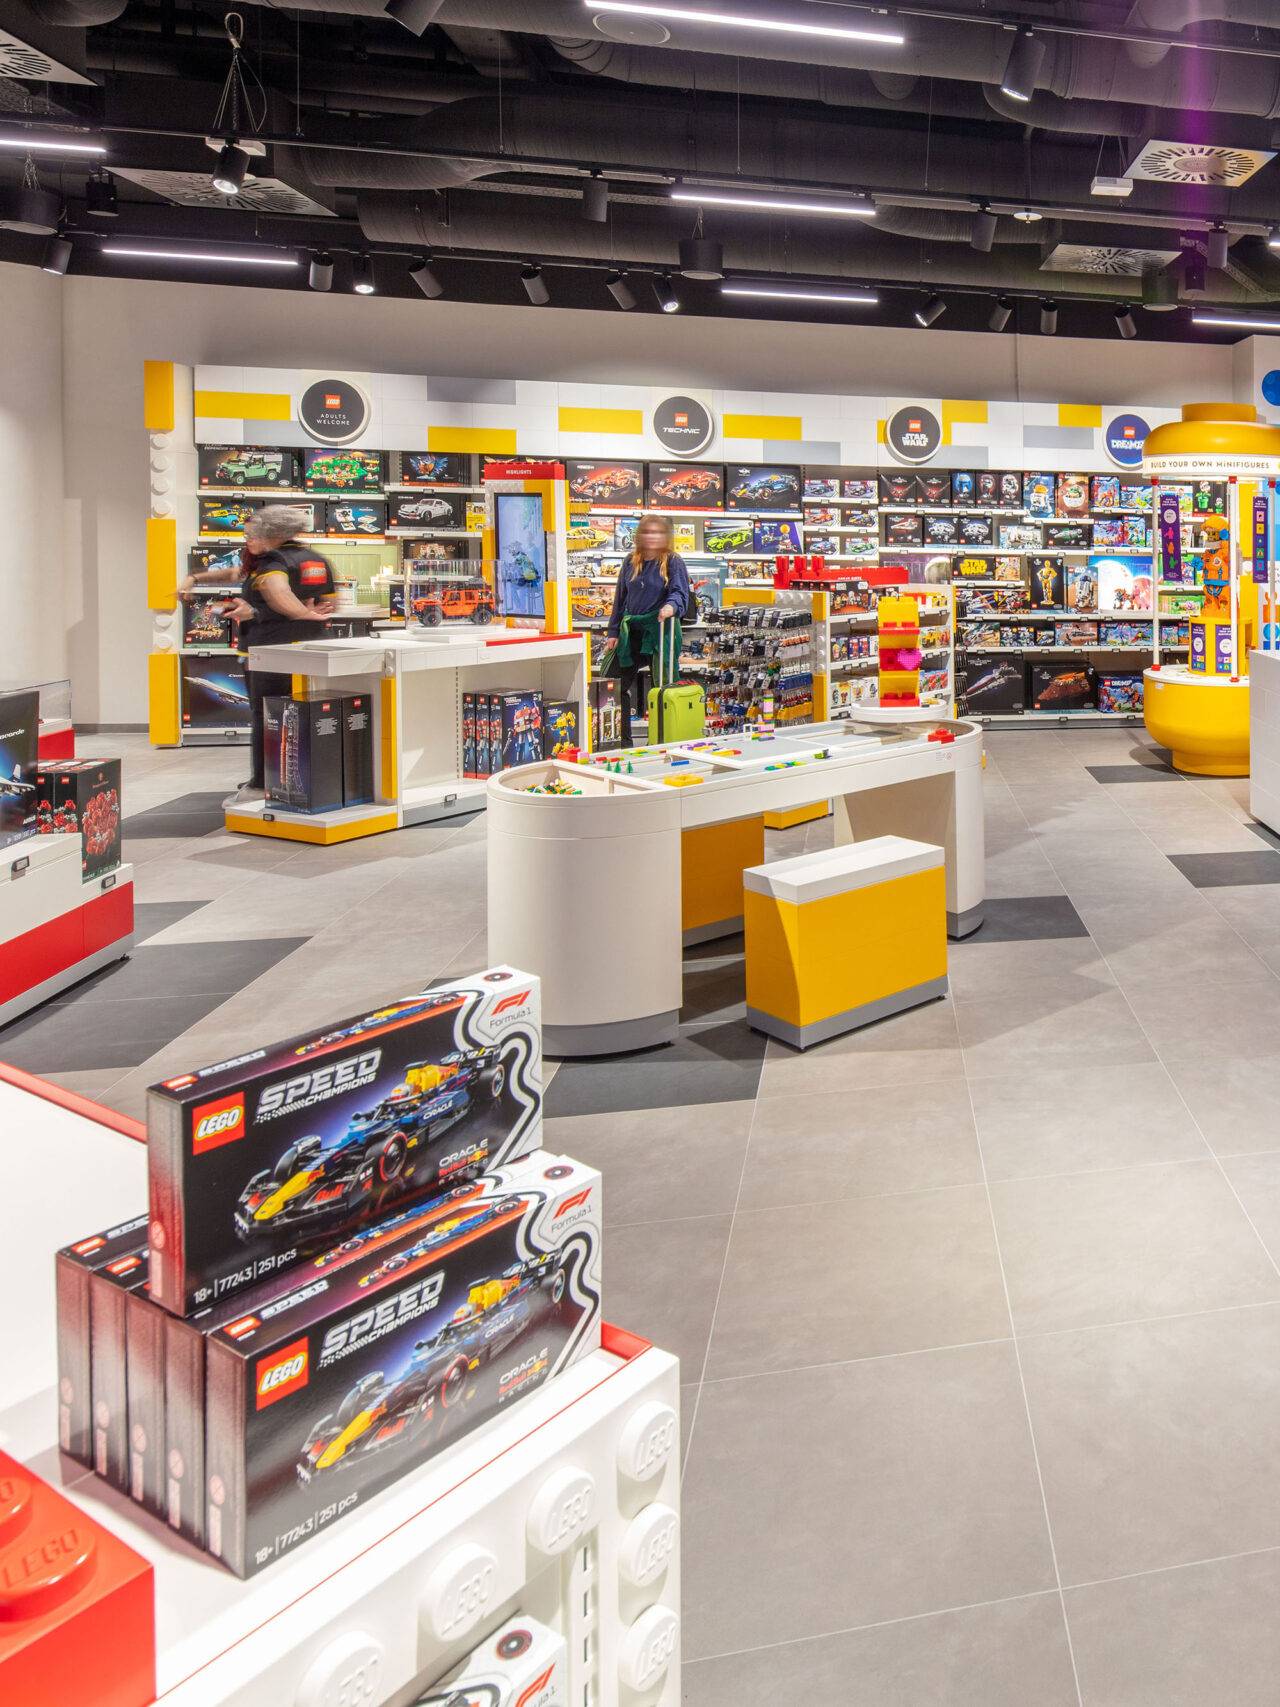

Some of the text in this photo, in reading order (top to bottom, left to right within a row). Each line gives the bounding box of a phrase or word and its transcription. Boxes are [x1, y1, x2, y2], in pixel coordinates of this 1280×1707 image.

[902, 438, 929, 447] WARS
[904, 433, 927, 441] STAR
[1191, 460, 1213, 468] OWN
[960, 564, 988, 576] WARS
[964, 559, 986, 567] STAR
[489, 1010, 524, 1029] Formula
[258, 1047, 382, 1116] SPEED
[303, 1070, 377, 1107] CHAMPIONS
[193, 1104, 242, 1143] LEGO
[423, 1099, 453, 1120] ORACLE
[439, 1138, 489, 1168] ORACLE
[439, 1158, 489, 1186] RACING
[314, 1183, 343, 1203] Bull
[551, 1212, 582, 1234] Formula
[193, 1247, 297, 1303] 18+ 77243 251 pcs
[322, 1269, 446, 1355] SPEED
[368, 1297, 440, 1343] CHAMPIONS
[484, 1313, 515, 1339] ORACLE
[258, 1355, 306, 1396] LEGO
[500, 1347, 548, 1384] ORACLE
[376, 1415, 406, 1441] Bull
[637, 1419, 675, 1476] LEGO
[254, 1491, 358, 1565] 18+ 77243 251 pcs
[548, 1484, 591, 1549] LEGO
[2, 1527, 81, 1587] LEGO
[637, 1520, 676, 1581] LEGO
[440, 1564, 493, 1637] LEGO
[638, 1623, 677, 1688] LEGO
